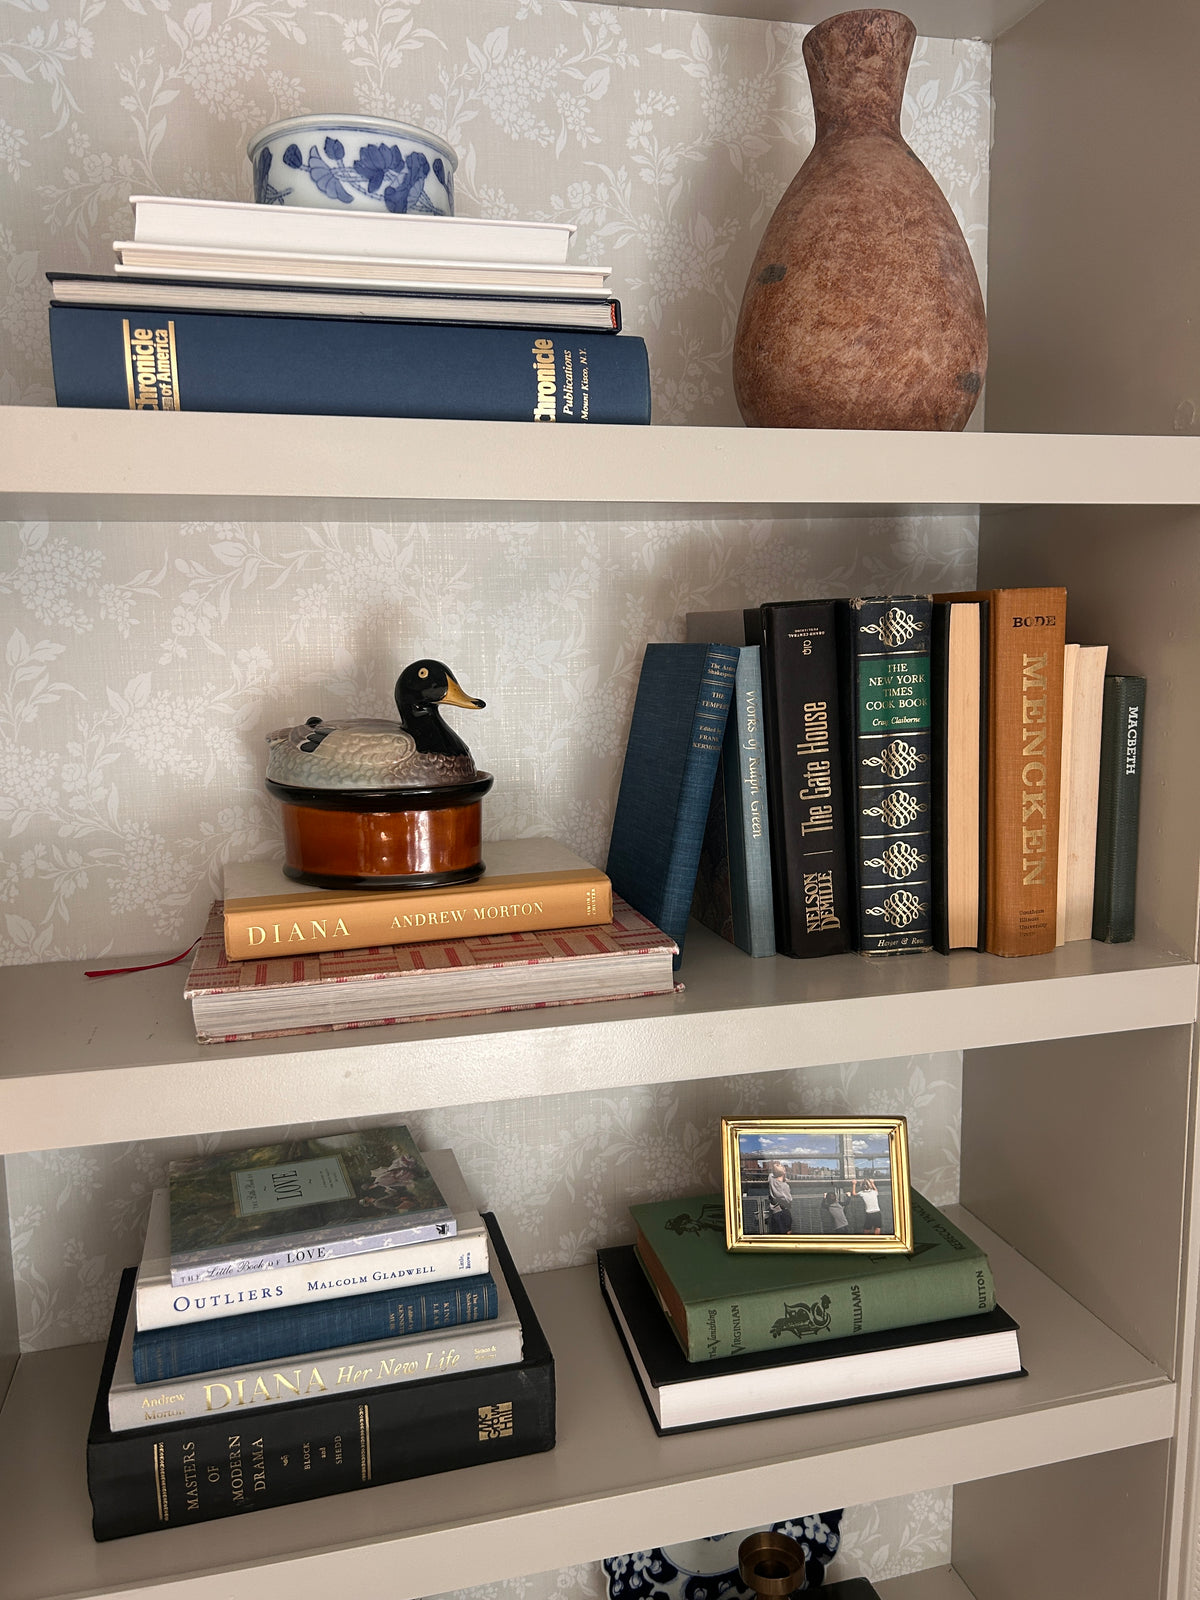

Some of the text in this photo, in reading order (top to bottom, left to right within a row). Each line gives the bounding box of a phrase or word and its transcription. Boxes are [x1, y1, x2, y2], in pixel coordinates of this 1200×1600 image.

[131, 328, 159, 410] Chronicle
[153, 329, 173, 396] of America
[532, 338, 557, 422] Chronicle
[562, 349, 574, 415] Publications
[580, 367, 589, 391] Kisco,
[580, 393, 589, 420] Mount
[1012, 616, 1056, 628] BODE
[868, 673, 926, 687] NEW YORK
[887, 663, 908, 674] THE
[744, 689, 760, 733] Works
[865, 697, 928, 711] COOK BOOK
[882, 686, 914, 698] TIMES
[743, 737, 762, 753] of
[1125, 706, 1139, 775] MACBETH
[796, 701, 833, 837] The Gate House
[1021, 652, 1048, 887] MENCKEN
[750, 799, 764, 840] Green
[247, 901, 544, 946] DIANA ANDREW MORTON
[803, 872, 821, 934] NELSON
[900, 937, 909, 945] &
[271, 1170, 303, 1200] LOVE
[180, 1274, 200, 1284] THE
[206, 1264, 234, 1279] Little
[236, 1258, 265, 1273] Book
[286, 1246, 326, 1264] LOVE
[173, 1265, 436, 1312] OUTLIERS MALCOLM GLADWELL
[850, 1284, 863, 1333] WILLIAMS
[975, 1270, 987, 1309] DUTTON
[705, 1309, 721, 1358] The Vanishing
[730, 1304, 746, 1355] VIRGINIAN
[142, 1392, 186, 1409] Andrew
[203, 1348, 462, 1412] DIANA Her New Life
[144, 1407, 186, 1421] Morton
[228, 1434, 244, 1504] MODERN
[251, 1437, 266, 1492] DRAMA
[302, 1441, 311, 1470] BLOCK
[334, 1435, 343, 1465] SHEDD
[182, 1441, 200, 1511] MASTERS
[207, 1465, 221, 1483] OF
